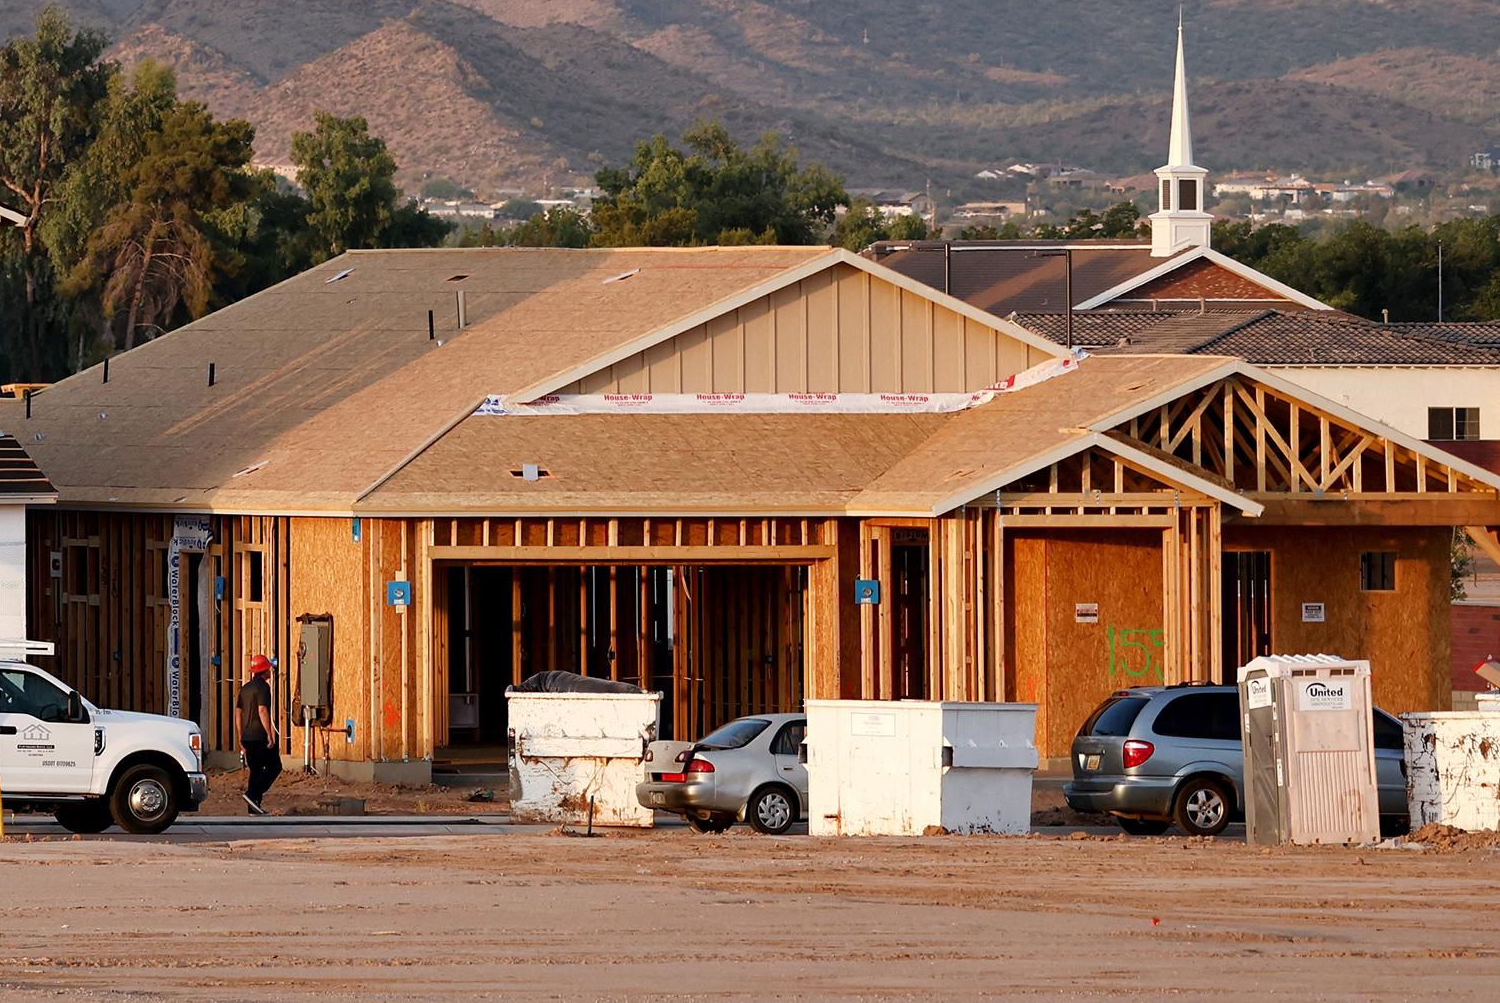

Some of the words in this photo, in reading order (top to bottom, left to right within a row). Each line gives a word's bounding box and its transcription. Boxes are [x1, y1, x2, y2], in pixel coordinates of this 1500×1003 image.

[604, 394, 653, 402] House-Wrap
[697, 393, 745, 401] House-Wrap
[789, 393, 837, 401] House-Wrap
[880, 394, 929, 402] House-Wrap
[171, 570, 179, 627] WaterBlock
[1310, 687, 1343, 697] United
